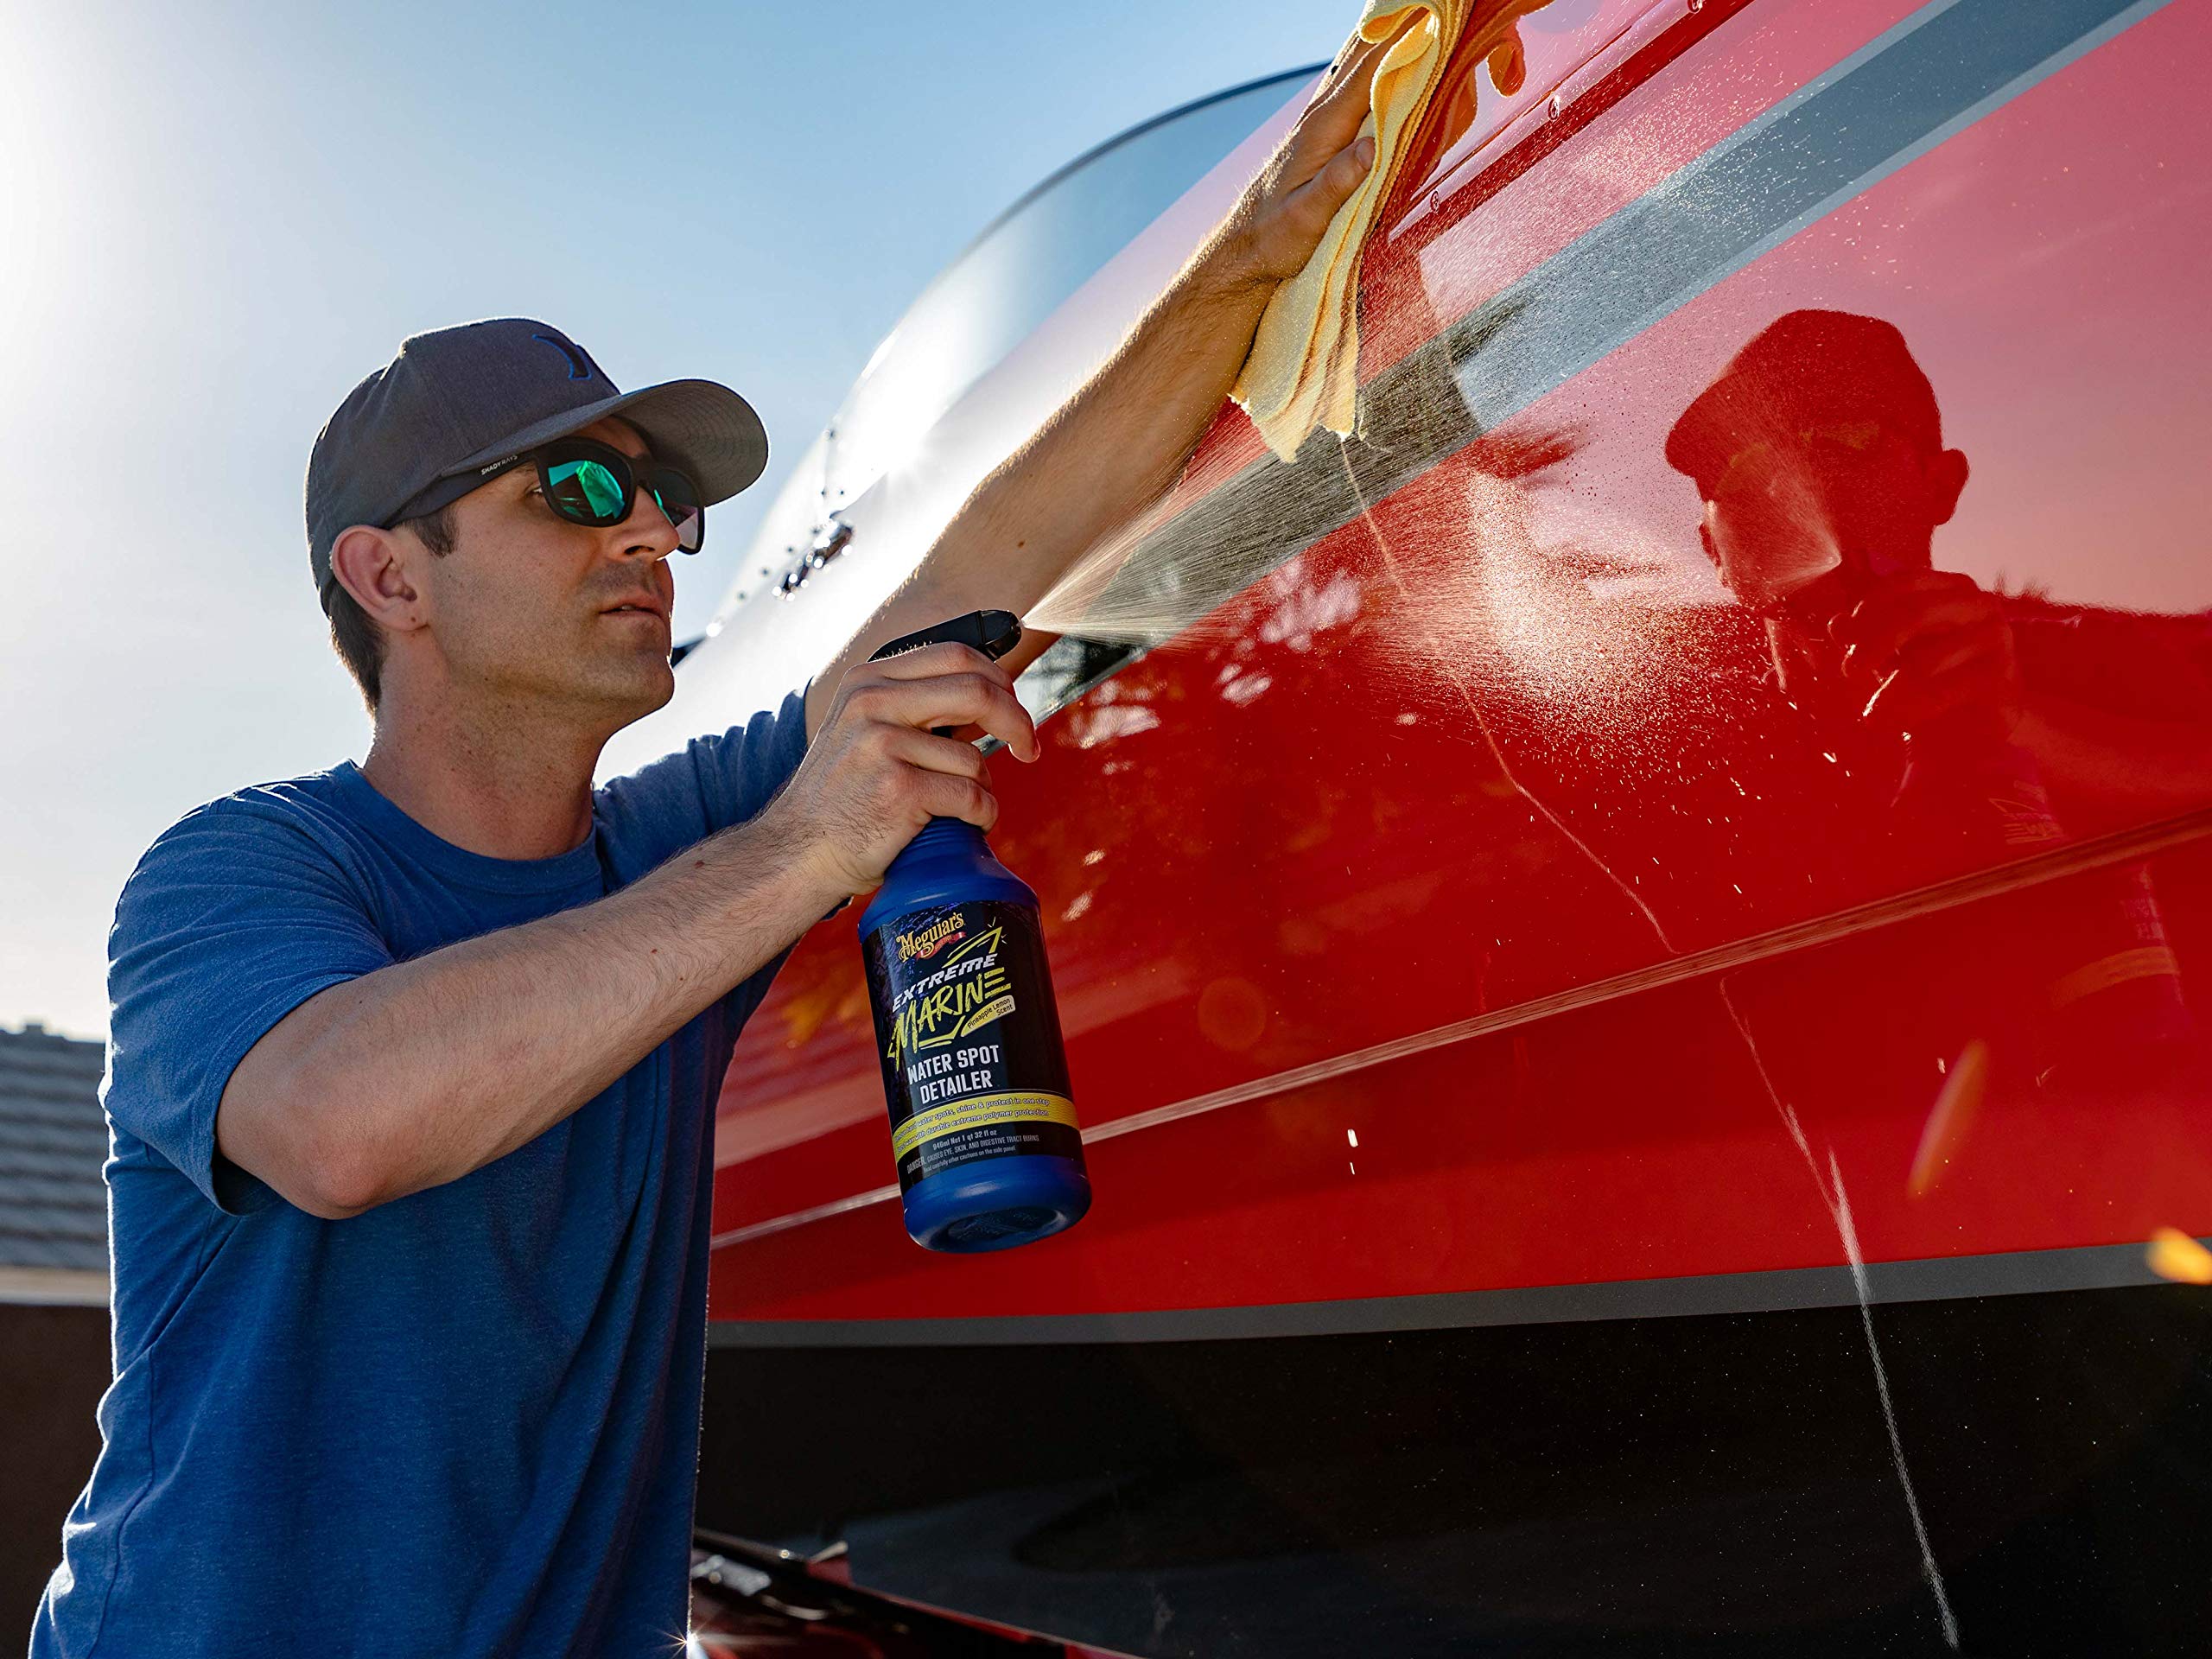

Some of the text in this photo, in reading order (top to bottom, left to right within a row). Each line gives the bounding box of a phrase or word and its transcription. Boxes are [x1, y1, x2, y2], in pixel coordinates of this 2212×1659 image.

[896, 912, 965, 963] Meguiar's
[893, 953, 998, 1013] EXTREME
[887, 967, 1012, 1072] MARINE
[968, 998, 1011, 1028] Pineapple Lemon
[995, 1004, 1014, 1015] Scent
[907, 1045, 1000, 1085] WATER SPOT
[919, 1070, 993, 1104] DETAILER
[957, 1103, 976, 1113] shine
[986, 1098, 1013, 1109] protect
[927, 1122, 951, 1135] durable
[951, 1114, 982, 1127] extreme
[983, 1109, 1013, 1121] polymer
[1014, 1109, 1049, 1118] protection
[926, 1150, 944, 1163] CAUSES
[969, 1141, 980, 1149] AND
[980, 1137, 1006, 1147] DIGESTIVE
[1006, 1135, 1022, 1143] TRACT
